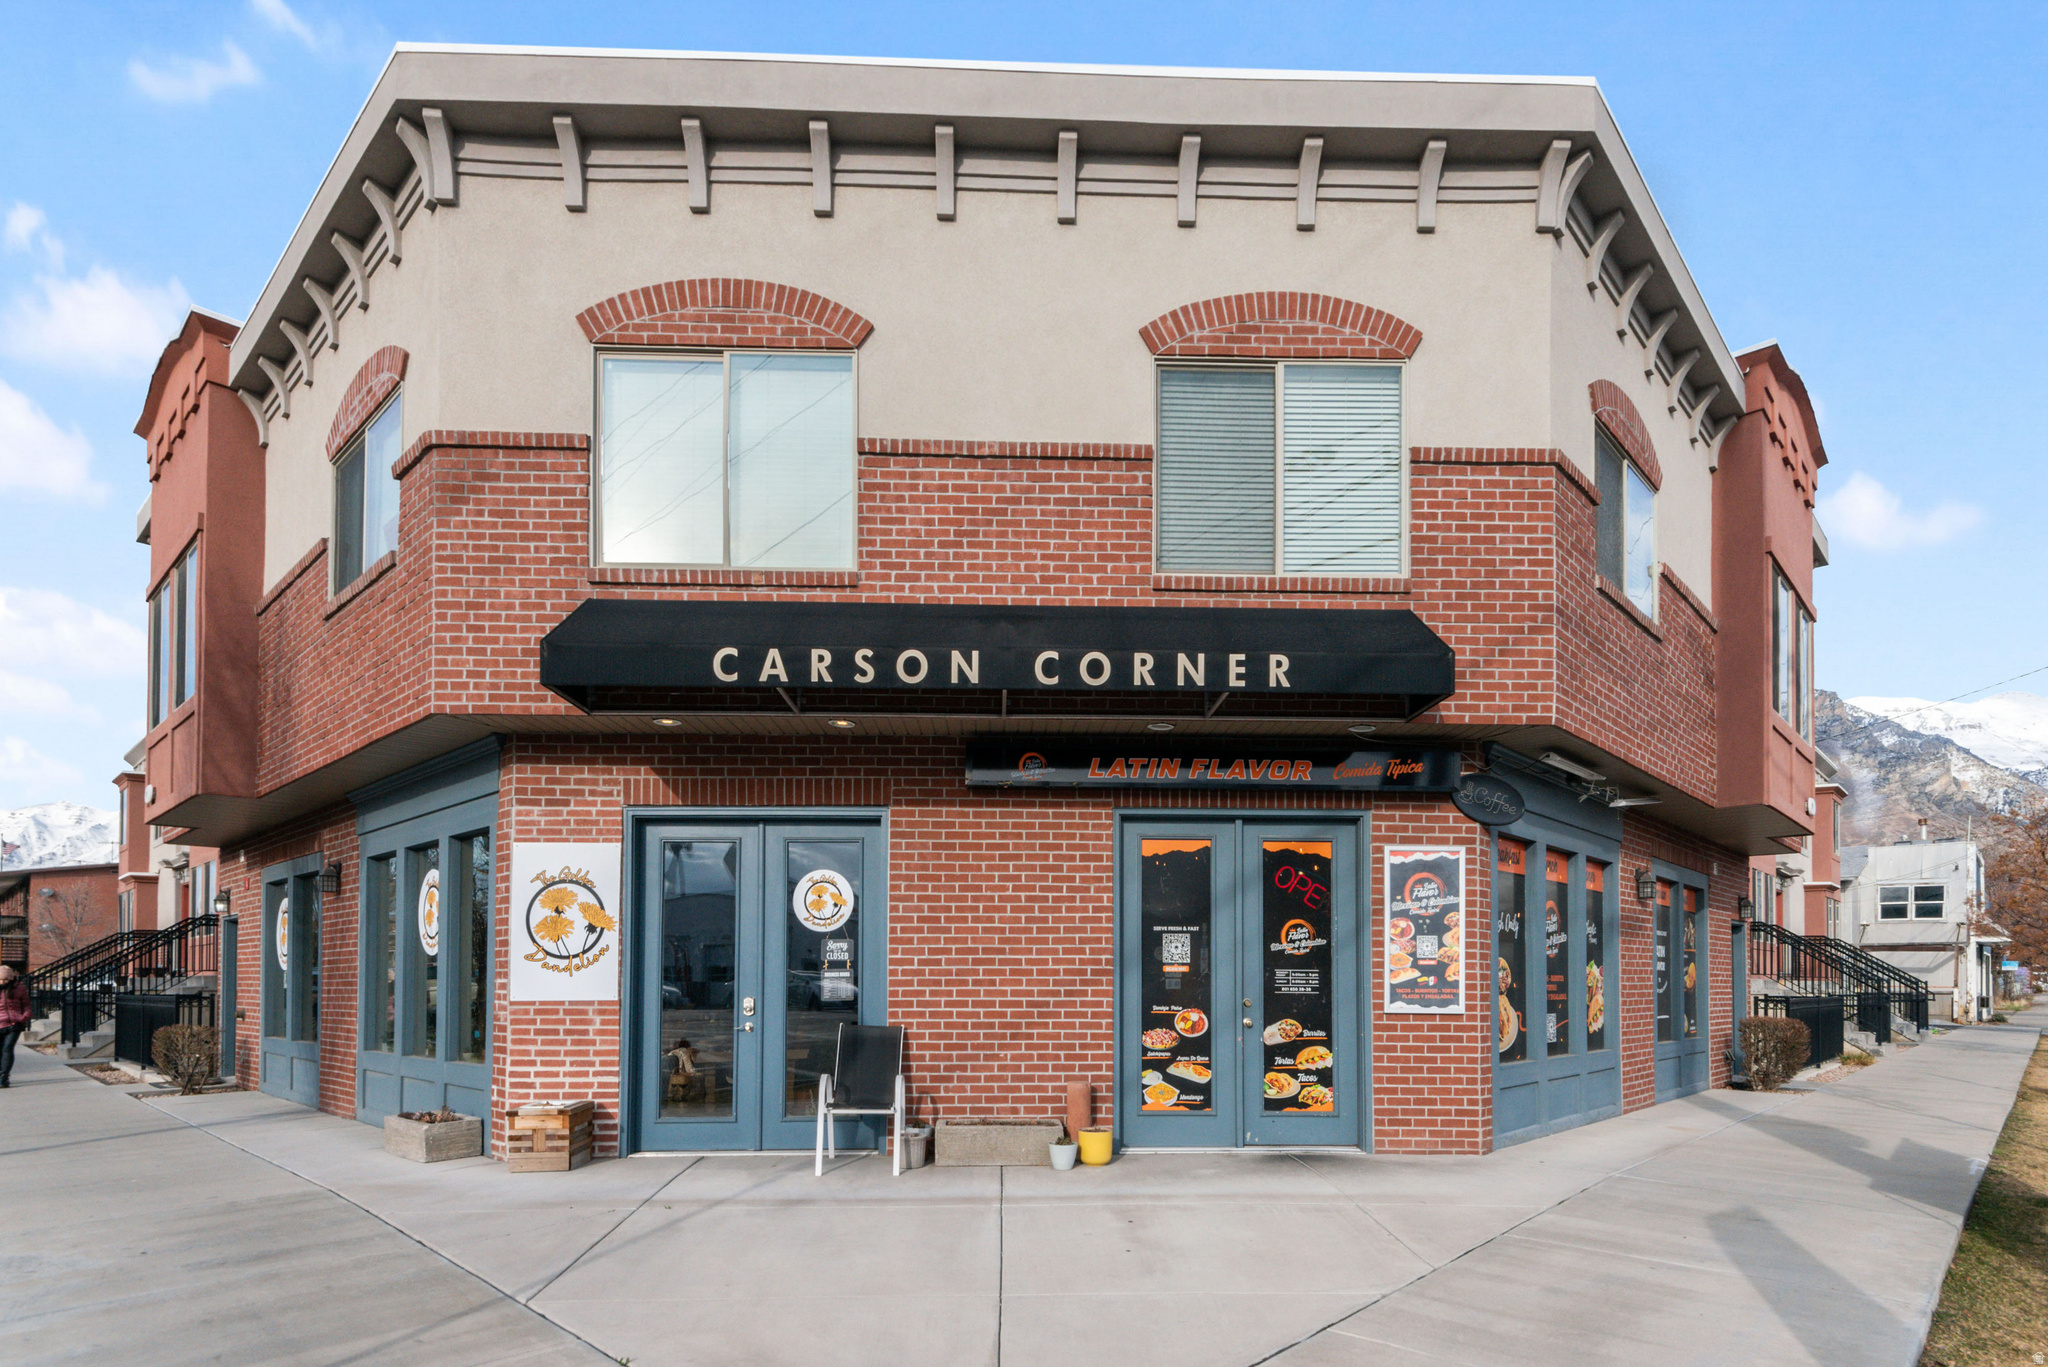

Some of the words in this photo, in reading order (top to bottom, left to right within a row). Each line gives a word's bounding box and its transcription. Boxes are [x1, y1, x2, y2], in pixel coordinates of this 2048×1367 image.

[712, 647, 980, 684] CARSON
[1034, 650, 1291, 688] CORNER
[1088, 758, 1181, 778] LATIN
[1188, 758, 1313, 781] FLAVOR
[1333, 761, 1384, 780] Comida
[1474, 787, 1517, 816] Coffee
[530, 869, 557, 887] The
[558, 866, 597, 889] Golden
[1275, 866, 1328, 909] OPE
[826, 940, 848, 951] Sorry
[826, 952, 849, 960] CLOSED
[524, 942, 609, 977] Dandelion
[1303, 1029, 1326, 1037] Burritos
[1275, 1057, 1295, 1065] Tortas
[1298, 1073, 1318, 1082] Tacos
